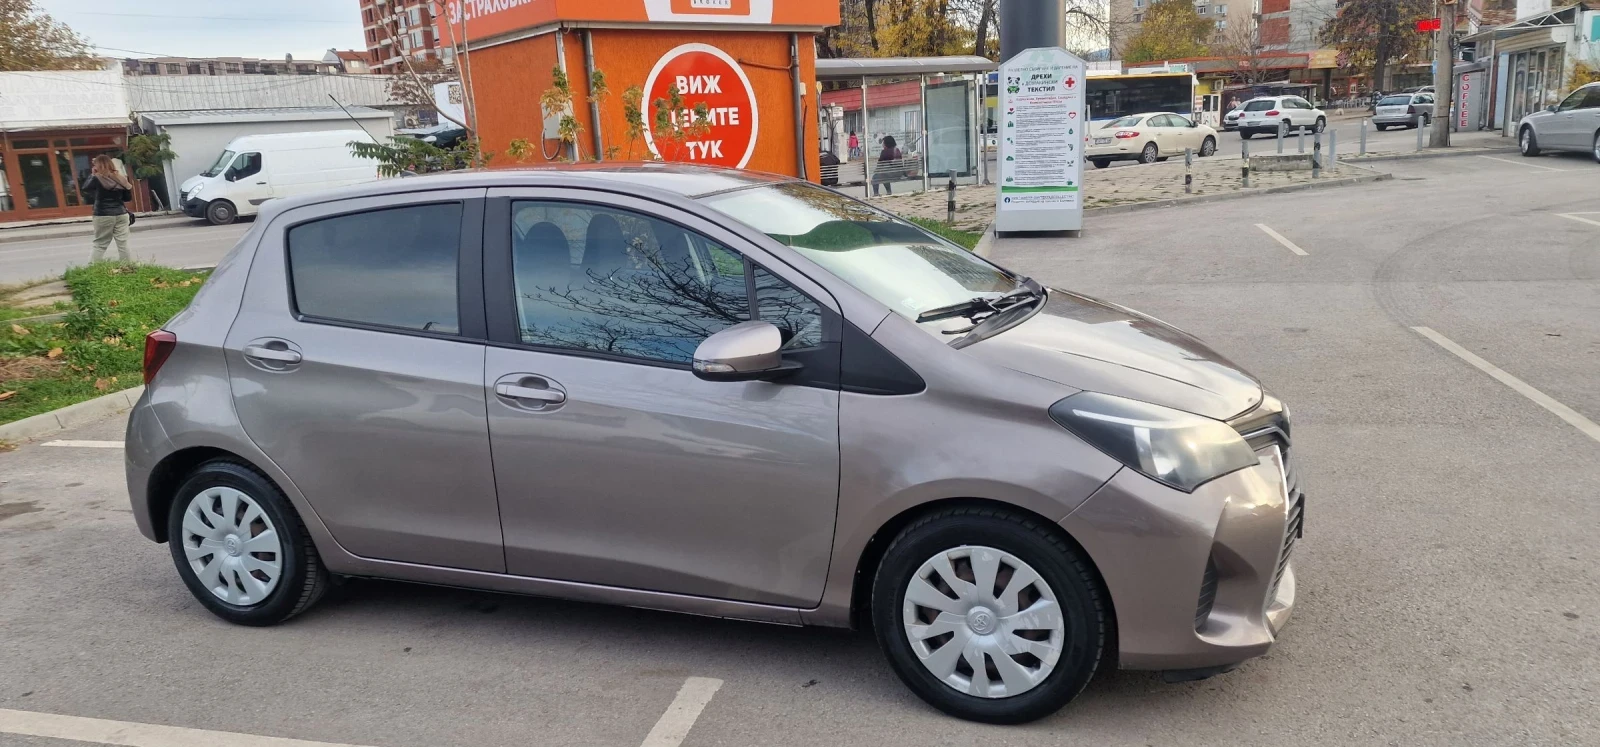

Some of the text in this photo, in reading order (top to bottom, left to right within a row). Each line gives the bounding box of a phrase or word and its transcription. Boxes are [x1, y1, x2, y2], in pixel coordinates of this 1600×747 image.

[675, 75, 722, 95] ВИЖ
[1461, 74, 1470, 127] COFFEE
[685, 140, 724, 160] ТУК
